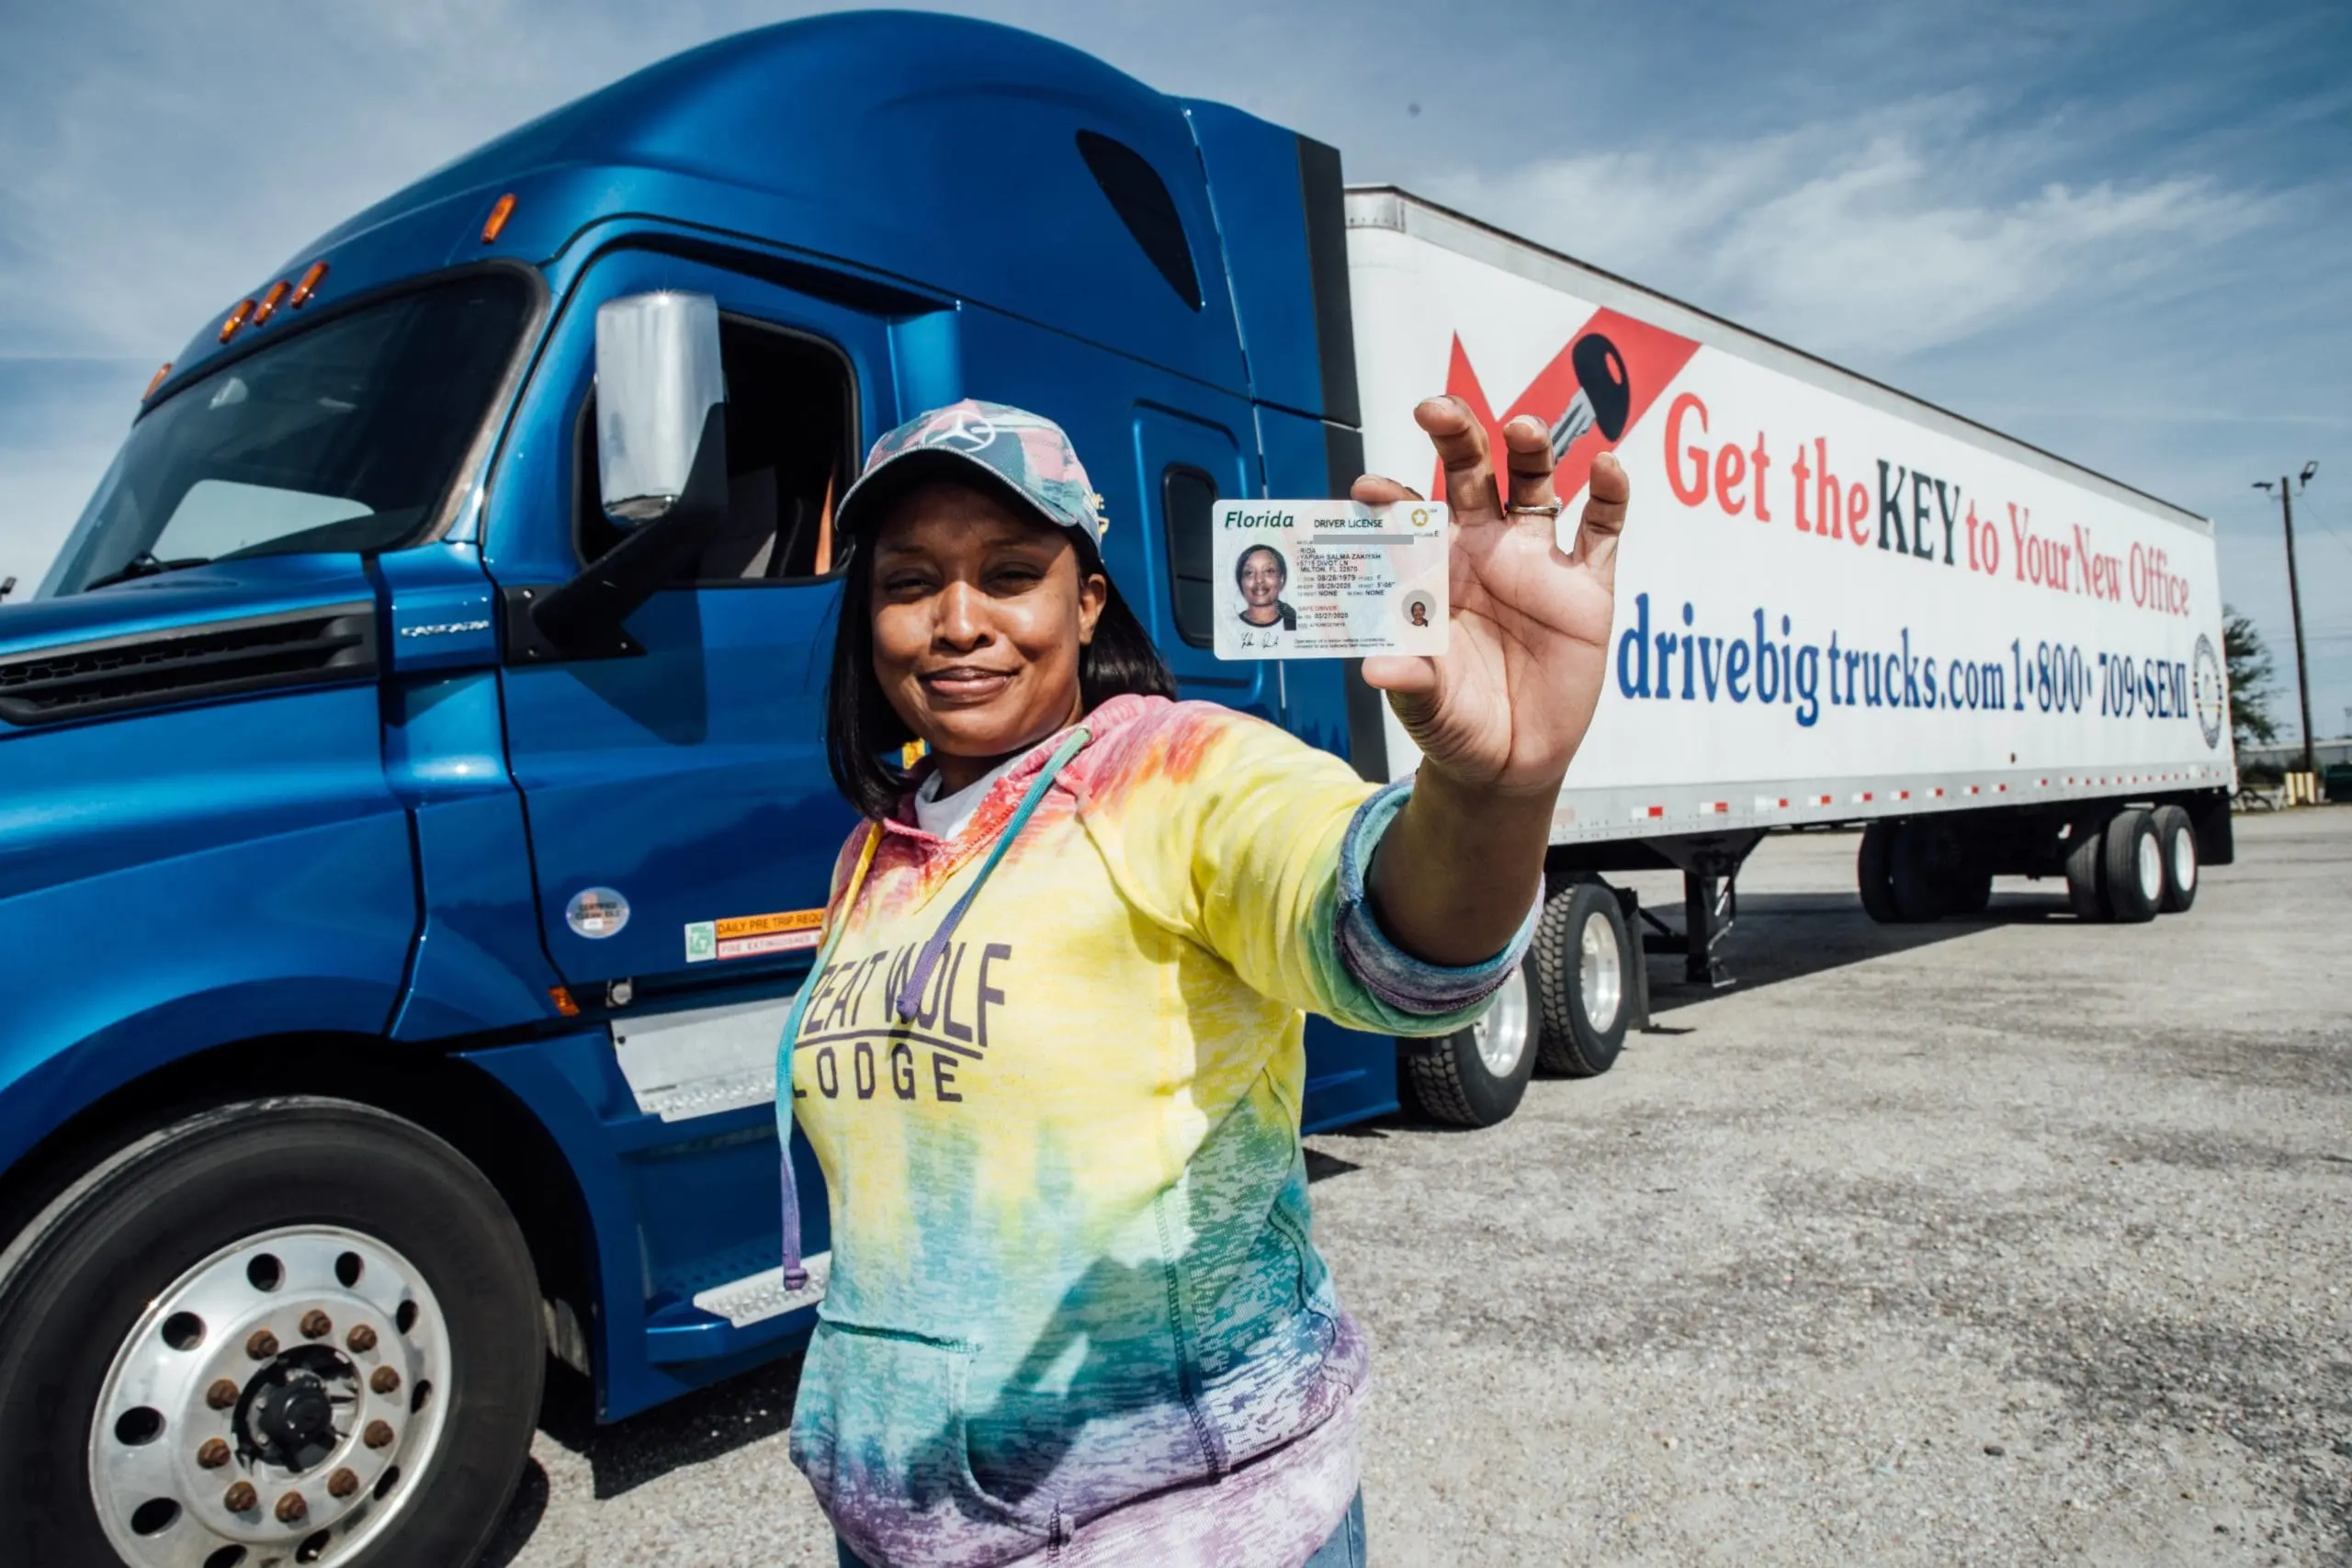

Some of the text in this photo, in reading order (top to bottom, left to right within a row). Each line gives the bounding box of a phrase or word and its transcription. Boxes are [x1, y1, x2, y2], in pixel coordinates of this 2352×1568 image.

[1664, 392, 2190, 618] Get the KEY to Your New Office
[1225, 510, 1295, 528] Florida
[1314, 519, 1384, 528] DRIVER LICENSE
[718, 922, 745, 934] DAILY
[749, 919, 769, 931] PRE
[773, 916, 795, 928] TRIP
